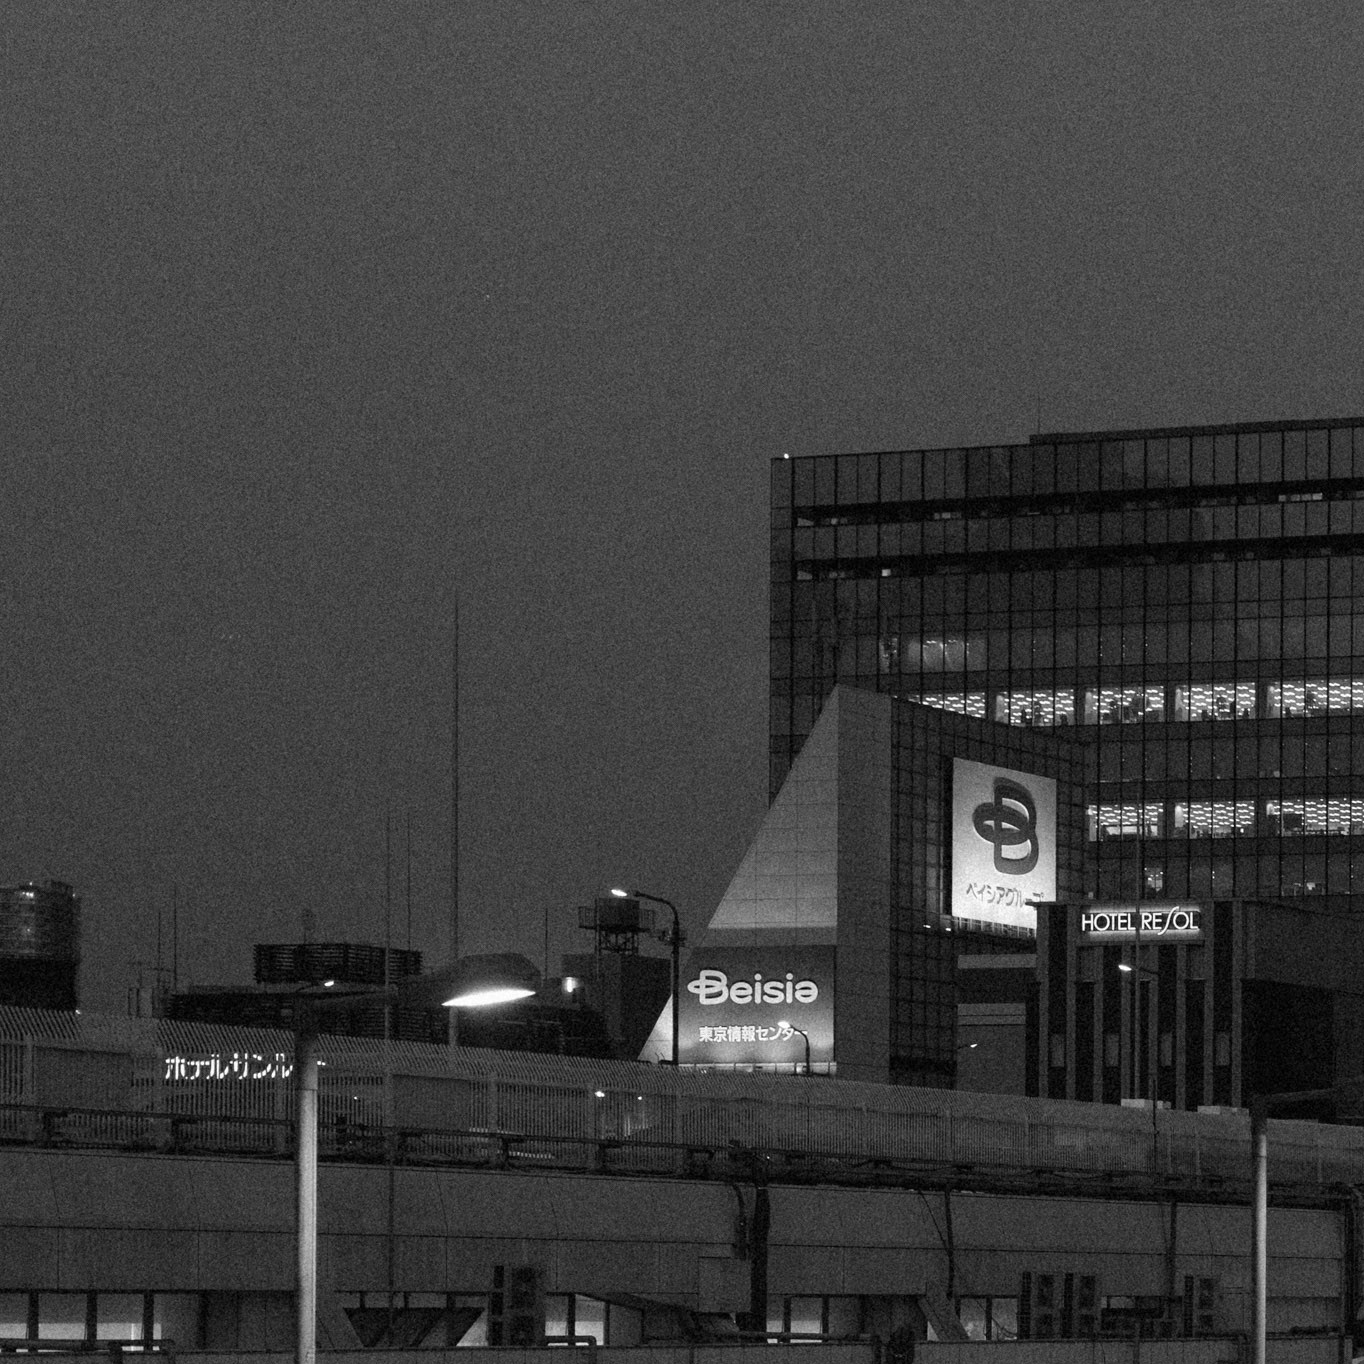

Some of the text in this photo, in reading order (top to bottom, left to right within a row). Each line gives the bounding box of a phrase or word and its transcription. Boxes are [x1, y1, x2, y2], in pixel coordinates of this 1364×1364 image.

[1081, 905, 1199, 935] HOTEL RESOL
[687, 969, 819, 1005] Beisia
[699, 1024, 808, 1043] 東京情報センター
[165, 1052, 326, 1080] ホテルサンル
